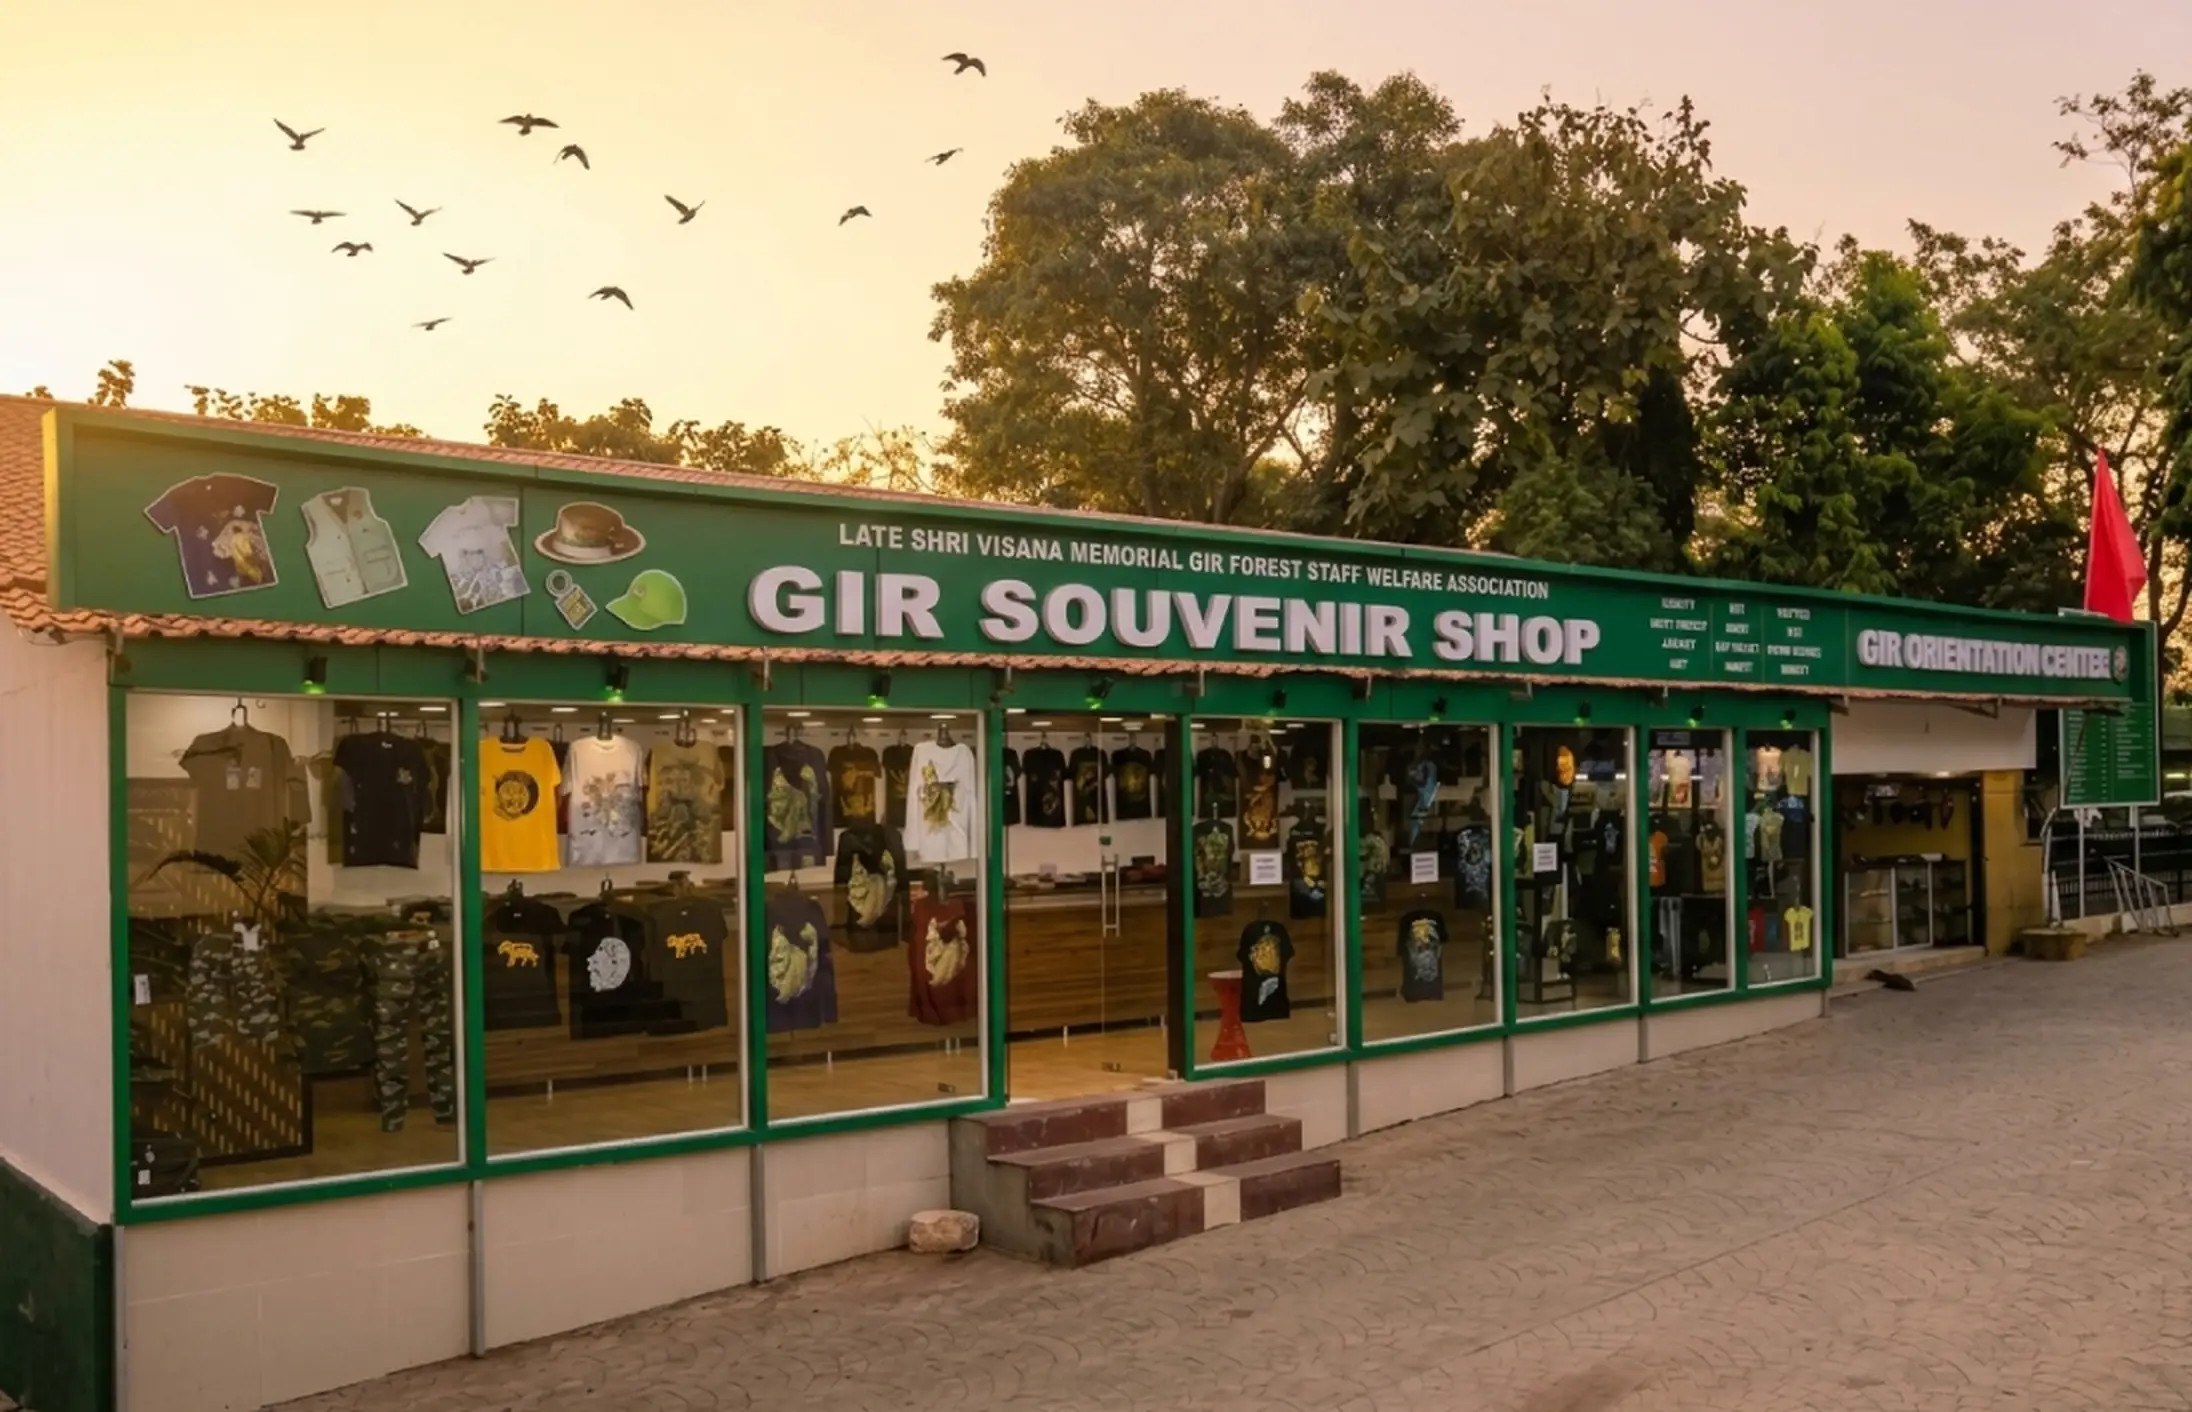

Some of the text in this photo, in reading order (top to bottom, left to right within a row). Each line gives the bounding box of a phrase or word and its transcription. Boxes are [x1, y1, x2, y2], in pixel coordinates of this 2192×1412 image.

[839, 523, 1549, 599] LATE SHRI VISANA MEMORIAL GIR FOREST STAFF WELFARE ASSOCIATION
[747, 564, 1601, 664] GIR SOUVENIR SHOP
[1857, 629, 1903, 667] GIR
[1903, 633, 2040, 676] ORIENTATION
